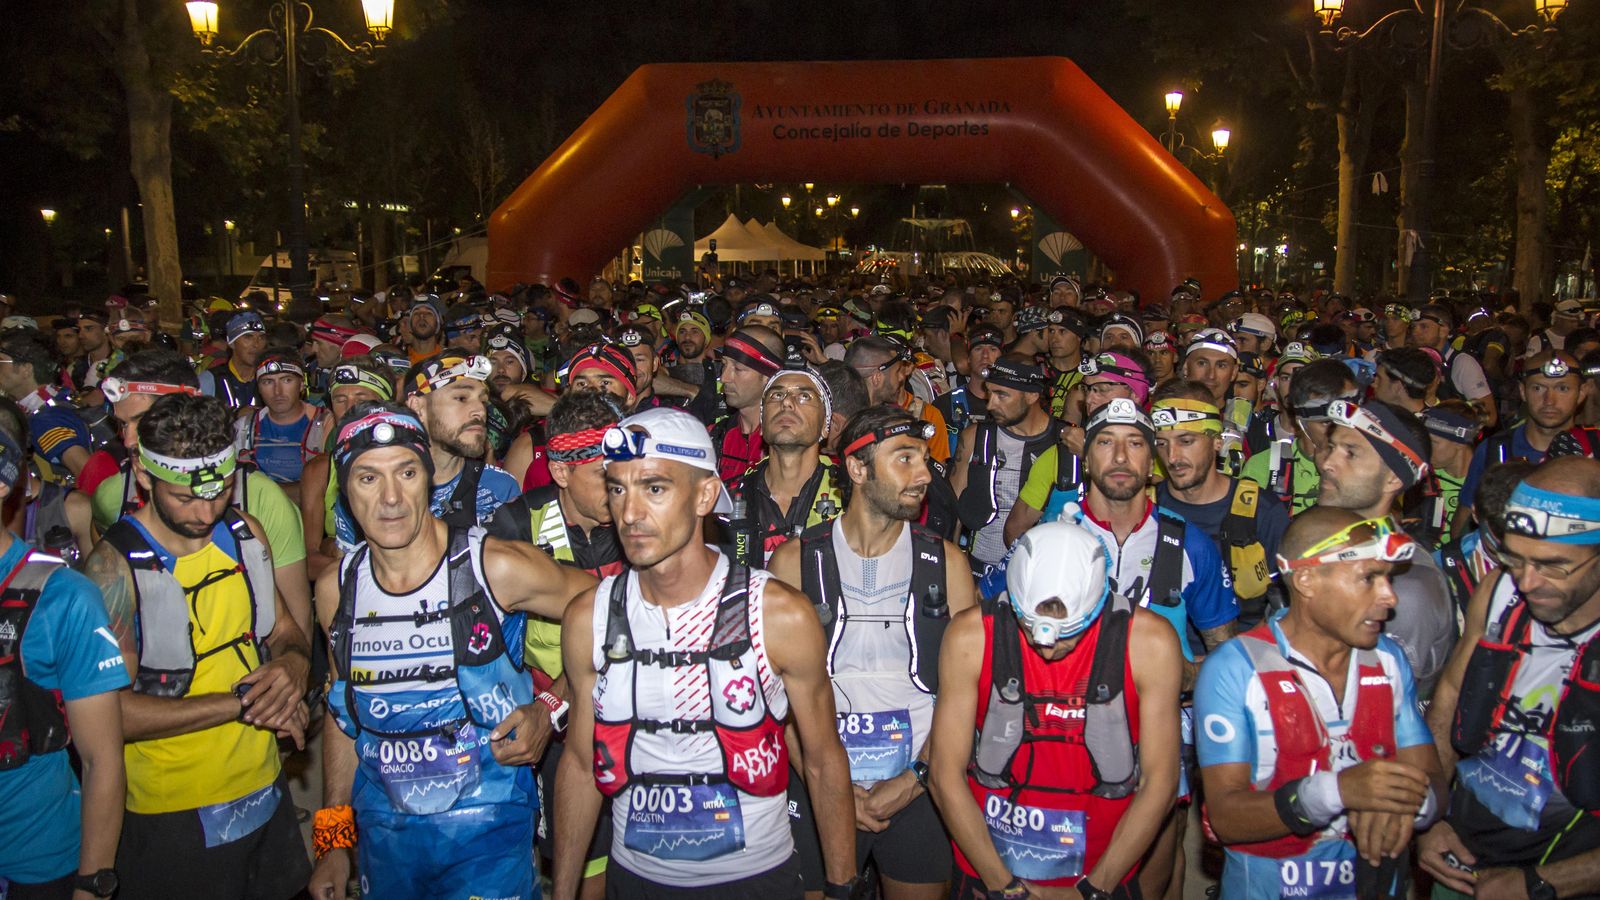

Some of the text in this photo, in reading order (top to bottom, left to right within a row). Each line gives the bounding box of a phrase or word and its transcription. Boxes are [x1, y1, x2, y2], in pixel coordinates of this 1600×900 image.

[896, 102, 917, 116] DE
[923, 99, 1011, 115] GRANADA
[772, 120, 989, 143] Concejalía de Deportes
[645, 266, 682, 280] Unicaja
[380, 738, 438, 764] 0086
[380, 764, 415, 774] IGNACIO
[631, 786, 694, 814] 0003
[629, 813, 666, 825] AGUSTIN
[987, 795, 1045, 832] 0280
[1281, 860, 1355, 887] 0178
[1283, 886, 1308, 897] JUAN
